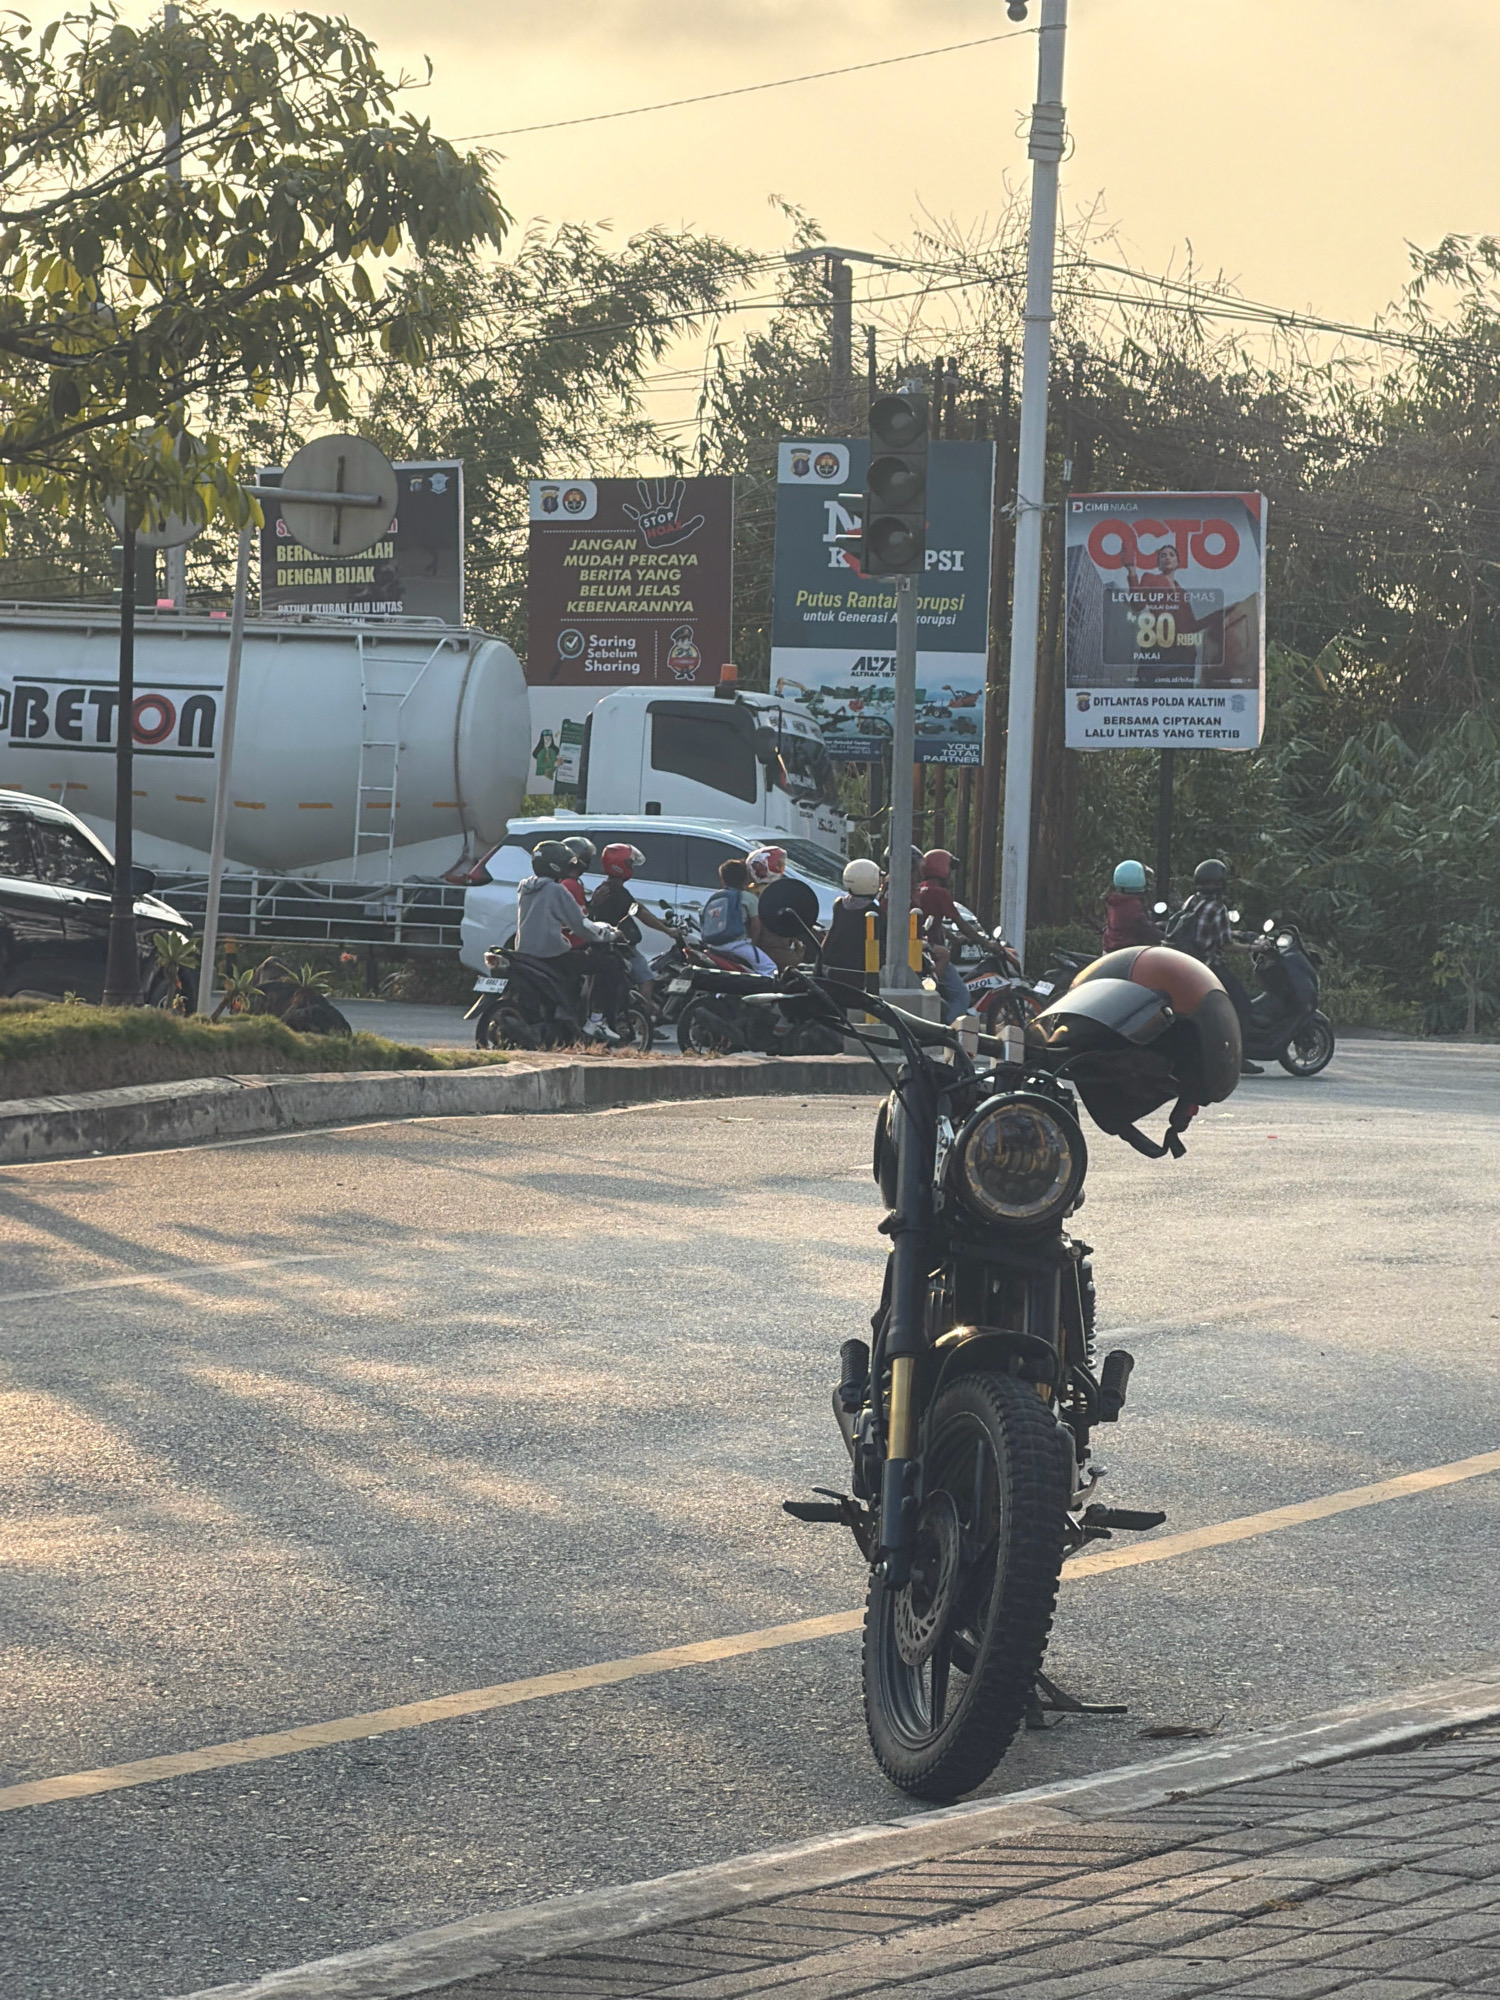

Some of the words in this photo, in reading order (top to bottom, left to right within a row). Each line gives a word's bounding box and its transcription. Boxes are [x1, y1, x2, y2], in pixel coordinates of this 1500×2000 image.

[1085, 503, 1109, 512] CIMB
[1110, 503, 1138, 511] NIAGA
[643, 511, 674, 528] STOP
[569, 539, 637, 551] JANGAN
[1088, 518, 1240, 570] OCTO
[563, 555, 624, 566] MUDAH
[629, 554, 698, 566] PERCAYA
[828, 547, 965, 571] KPSI
[277, 567, 332, 586] DENGAN
[335, 566, 375, 584] BIJAK
[579, 569, 632, 581] BERITA
[636, 569, 682, 581] YANG
[580, 585, 632, 597] BELUM
[636, 585, 681, 597] JELAS
[1112, 592, 1146, 602] LEVEL
[1149, 592, 1164, 602] UP
[1167, 592, 1180, 602] KE
[1184, 592, 1215, 602] EMAS
[312, 602, 347, 613] ATURAN
[349, 602, 370, 613] LALU
[372, 601, 404, 613] LINTAS
[566, 600, 694, 613] KEBENARANNYA
[796, 590, 842, 608] Putus
[847, 591, 898, 610] Rantai
[917, 594, 965, 614] orupsi
[803, 610, 834, 622] untuk
[838, 611, 888, 624] Generasi
[1137, 612, 1176, 648] 80
[1177, 633, 1204, 647] RIBU
[589, 635, 636, 649] Saring
[588, 648, 638, 659] Sebelum
[1133, 652, 1161, 661] PAKAI
[584, 660, 641, 675] Sharing
[1094, 697, 1149, 707] DITLANTAS
[1152, 697, 1185, 707] POLDA
[1188, 697, 1226, 707] KALTIM
[11, 685, 216, 748] BETON
[1103, 716, 1159, 726] BERSAMA
[1163, 716, 1222, 726] CIPTAKAN
[1085, 729, 1114, 738] LALU
[1118, 729, 1159, 738] LINTAS
[1163, 729, 1194, 738] YANG
[1198, 729, 1240, 739] TERTIB
[923, 755, 980, 763] PARTNER
[941, 749, 979, 757] TOTAL
